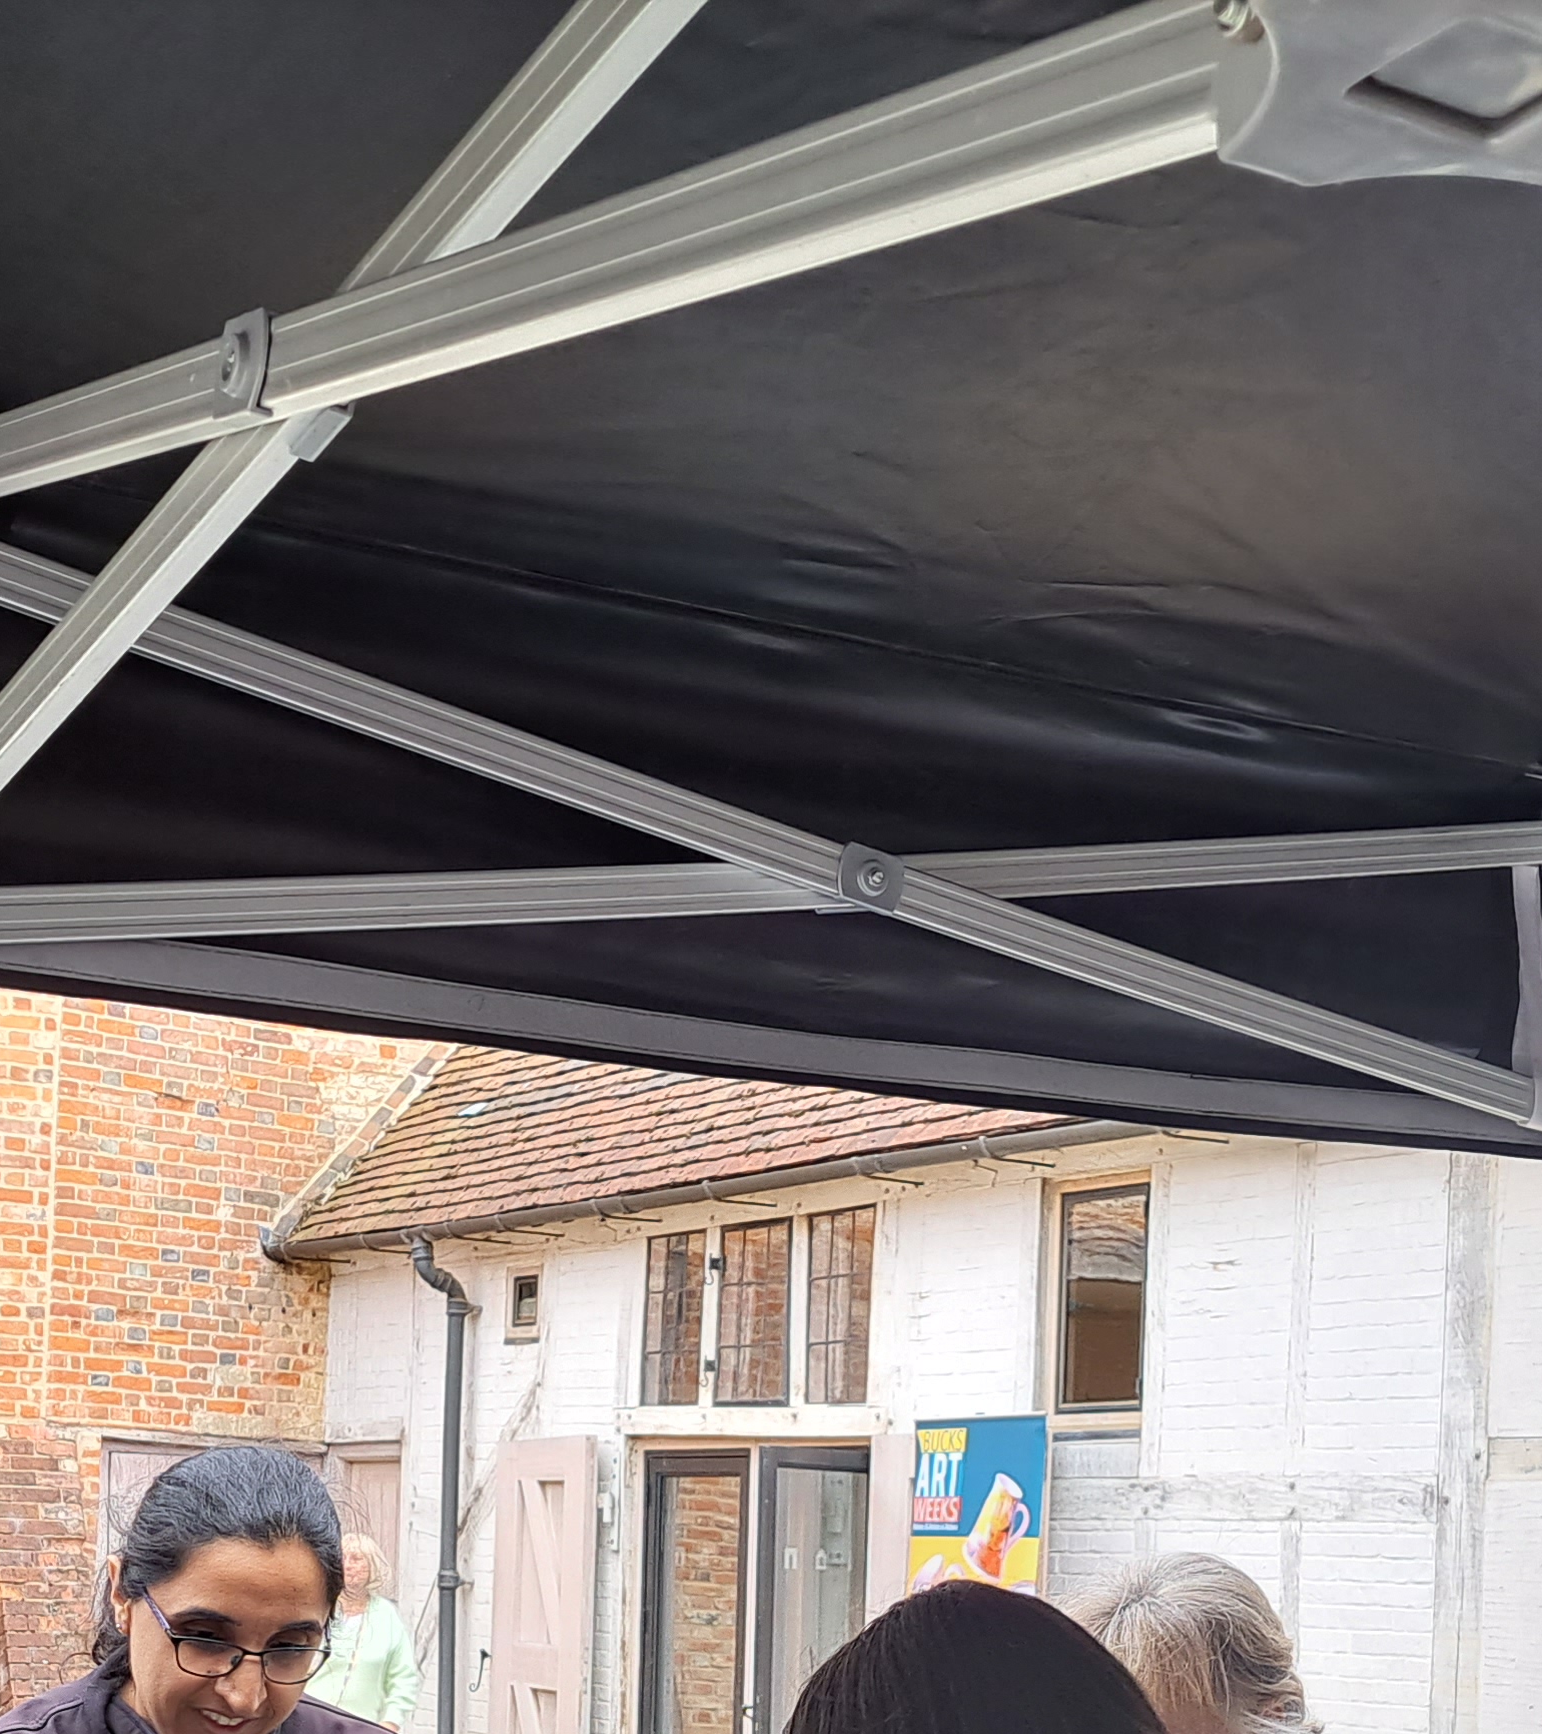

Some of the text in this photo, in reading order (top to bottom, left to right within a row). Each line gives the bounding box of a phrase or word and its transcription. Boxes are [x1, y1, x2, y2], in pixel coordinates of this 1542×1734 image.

[923, 1430, 963, 1451] BUCKS
[915, 1453, 963, 1497] ART
[914, 1498, 959, 1522] WEEKS
